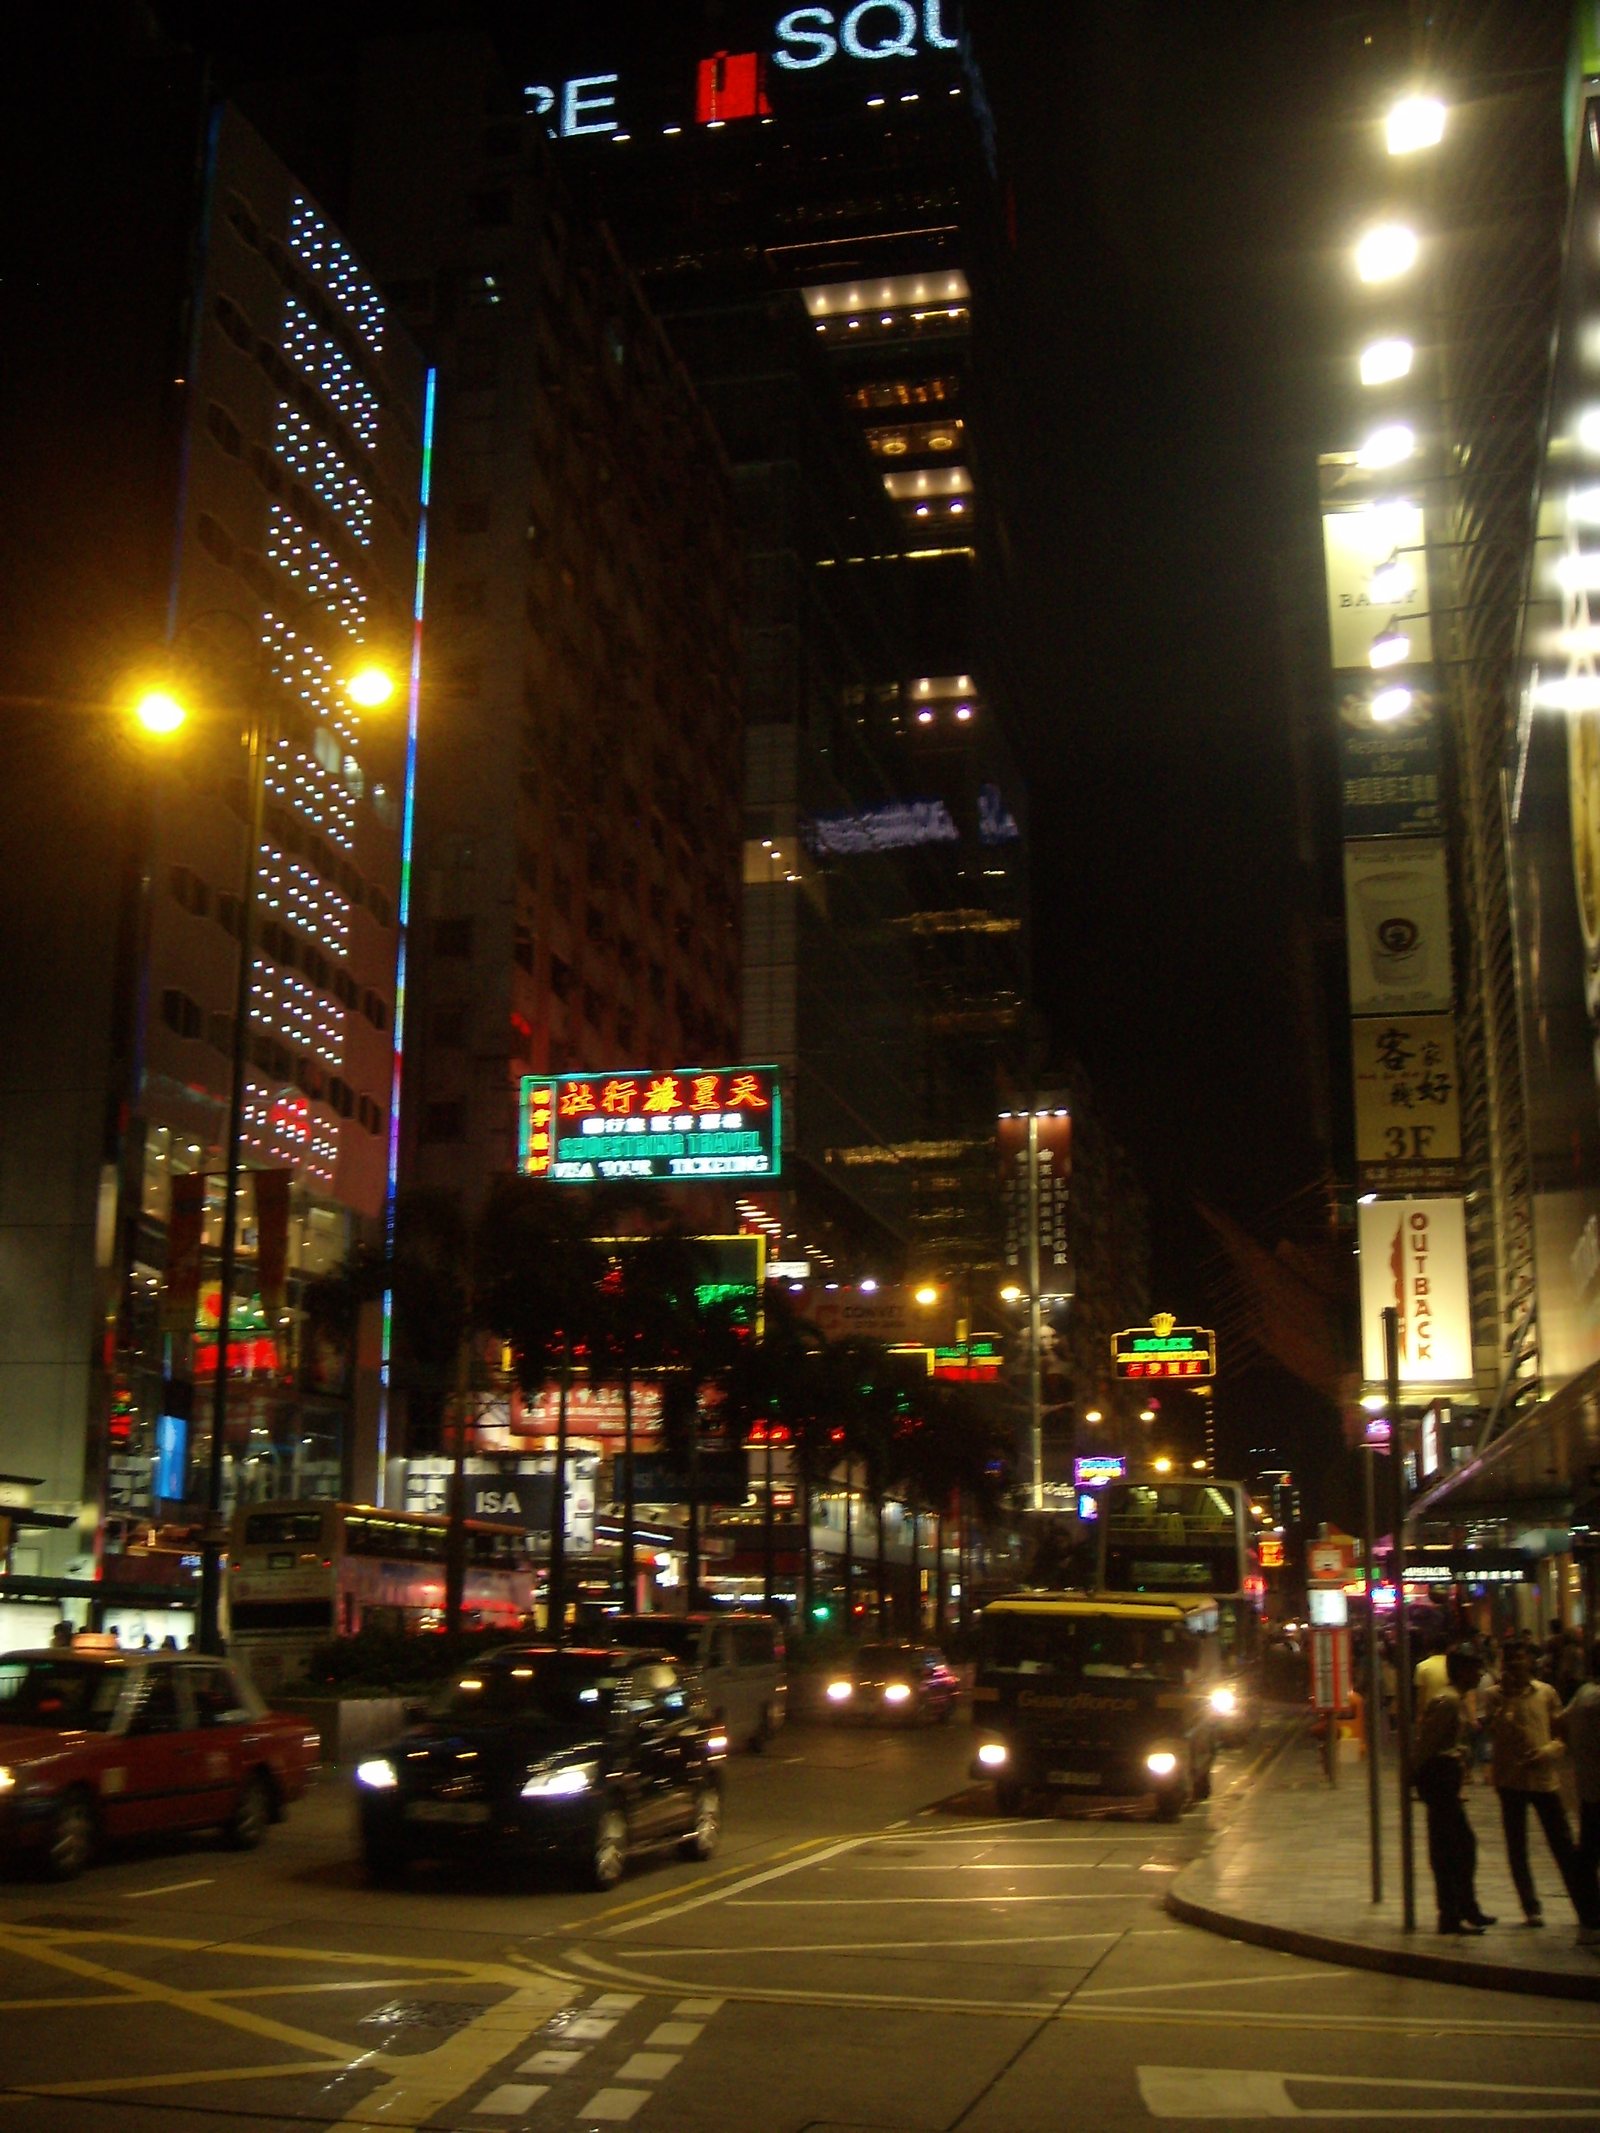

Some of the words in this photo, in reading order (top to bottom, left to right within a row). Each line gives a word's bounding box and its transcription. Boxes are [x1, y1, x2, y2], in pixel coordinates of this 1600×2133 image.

[1339, 588, 1417, 608] BAY
[686, 1131, 763, 1154] TRAVEL
[1384, 1125, 1435, 1159] 3F
[1410, 1212, 1432, 1360] OUTBACK
[475, 1491, 522, 1514] ISA
